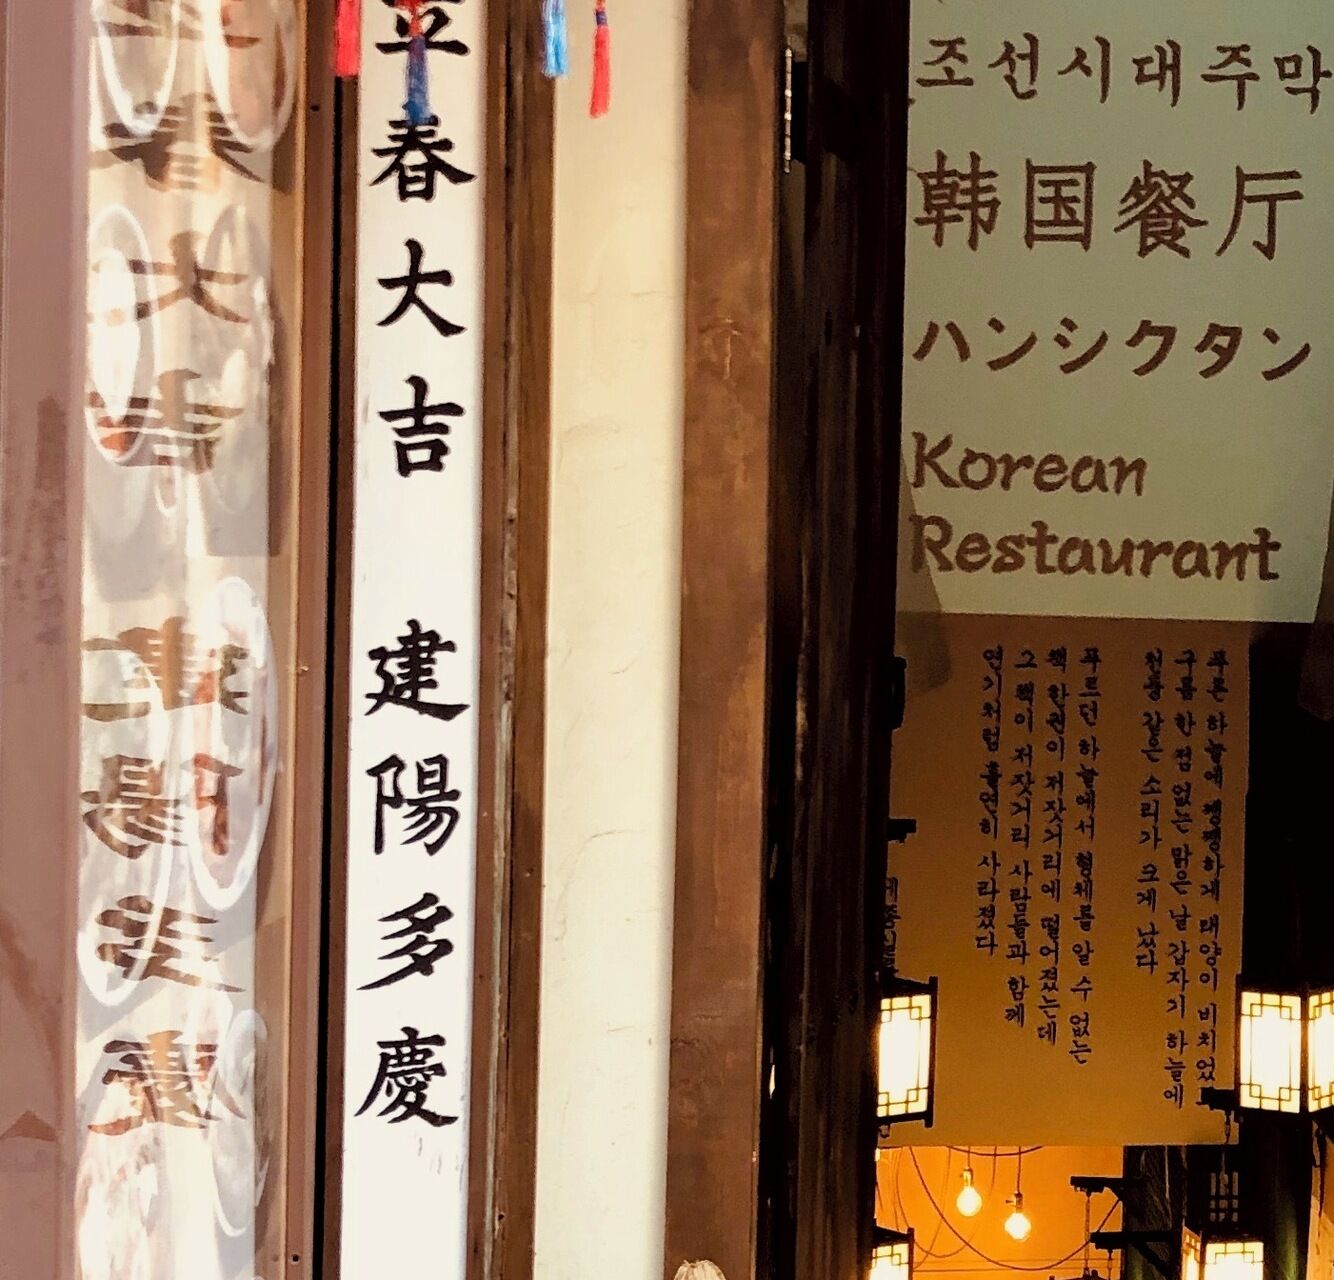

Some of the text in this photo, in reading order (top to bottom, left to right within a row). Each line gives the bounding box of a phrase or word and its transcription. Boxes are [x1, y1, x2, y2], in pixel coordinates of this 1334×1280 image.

[912, 148, 1306, 264] 韩国餐厅
[910, 314, 1314, 384] ハンシクタン
[909, 429, 1148, 497] Korean
[909, 513, 1283, 584] Restaurant
[1014, 648, 1038, 669] 그
[1078, 646, 1102, 728] 푸르던
[1205, 648, 1230, 703] 푸른
[981, 642, 1005, 753] 연기처럼
[1203, 710, 1228, 790] 하늘에
[1074, 734, 1100, 842] 하늘에서
[1138, 774, 1163, 851] 소리가
[350, 616, 474, 1129] 建陽多慶
[975, 849, 1002, 957] 사라졌다
[1135, 862, 1160, 913] 크게
[1163, 647, 1198, 1109] 구름 한 점 없는 맑은 날 갑자기 하늘에
[1005, 858, 1033, 965] 사람들과
[1135, 921, 1159, 976] 났다
[1069, 975, 1093, 1002] 수
[1071, 939, 1094, 967] 알
[1004, 975, 1031, 1028] 함께
[1068, 1011, 1093, 1065] 없는
[1195, 1001, 1220, 1105] 비치었
